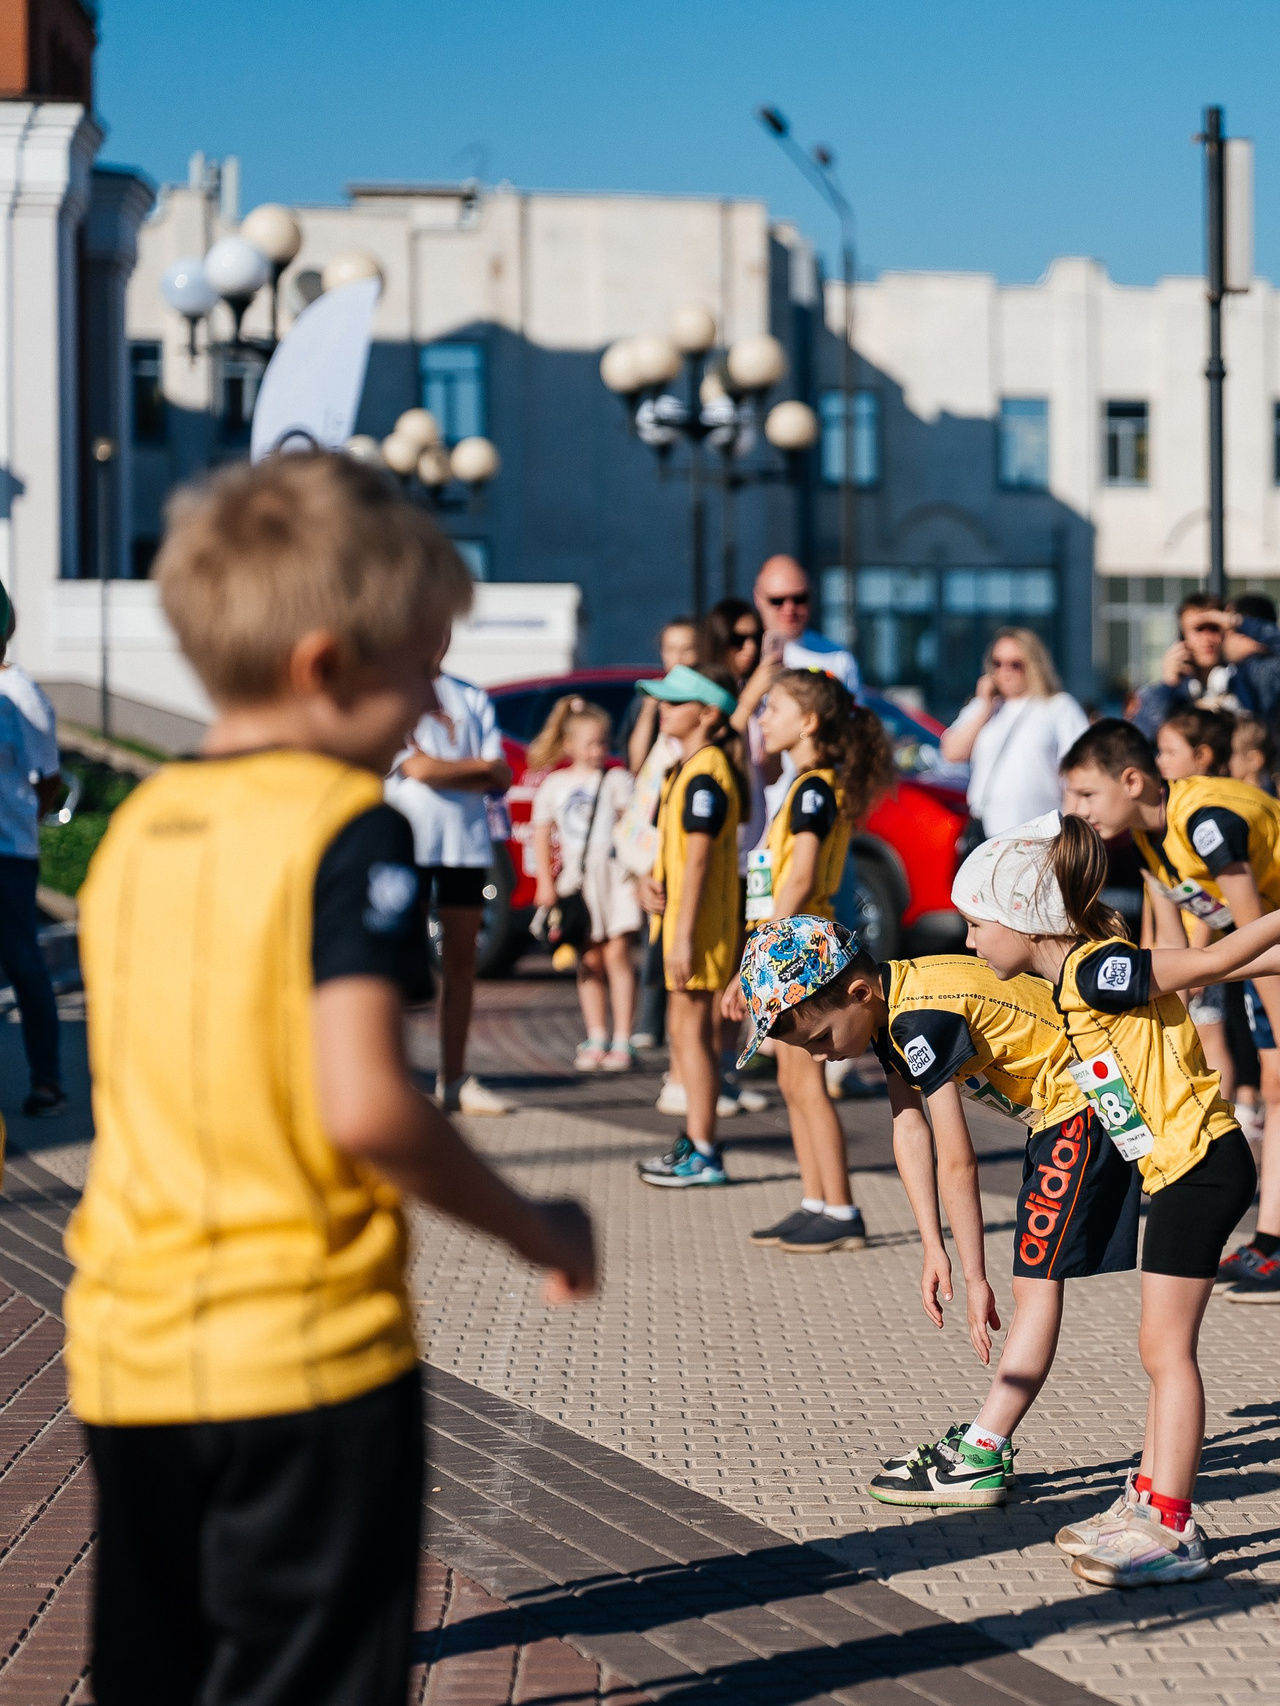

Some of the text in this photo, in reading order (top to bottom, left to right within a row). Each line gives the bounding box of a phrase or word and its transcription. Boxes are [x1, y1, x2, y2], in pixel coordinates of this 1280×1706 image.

[1106, 959, 1118, 987] Alpen
[1117, 962, 1127, 986] Gold
[907, 1045, 928, 1065] Alpen
[911, 1054, 931, 1073] Gold
[1019, 1115, 1084, 1266] adidas
